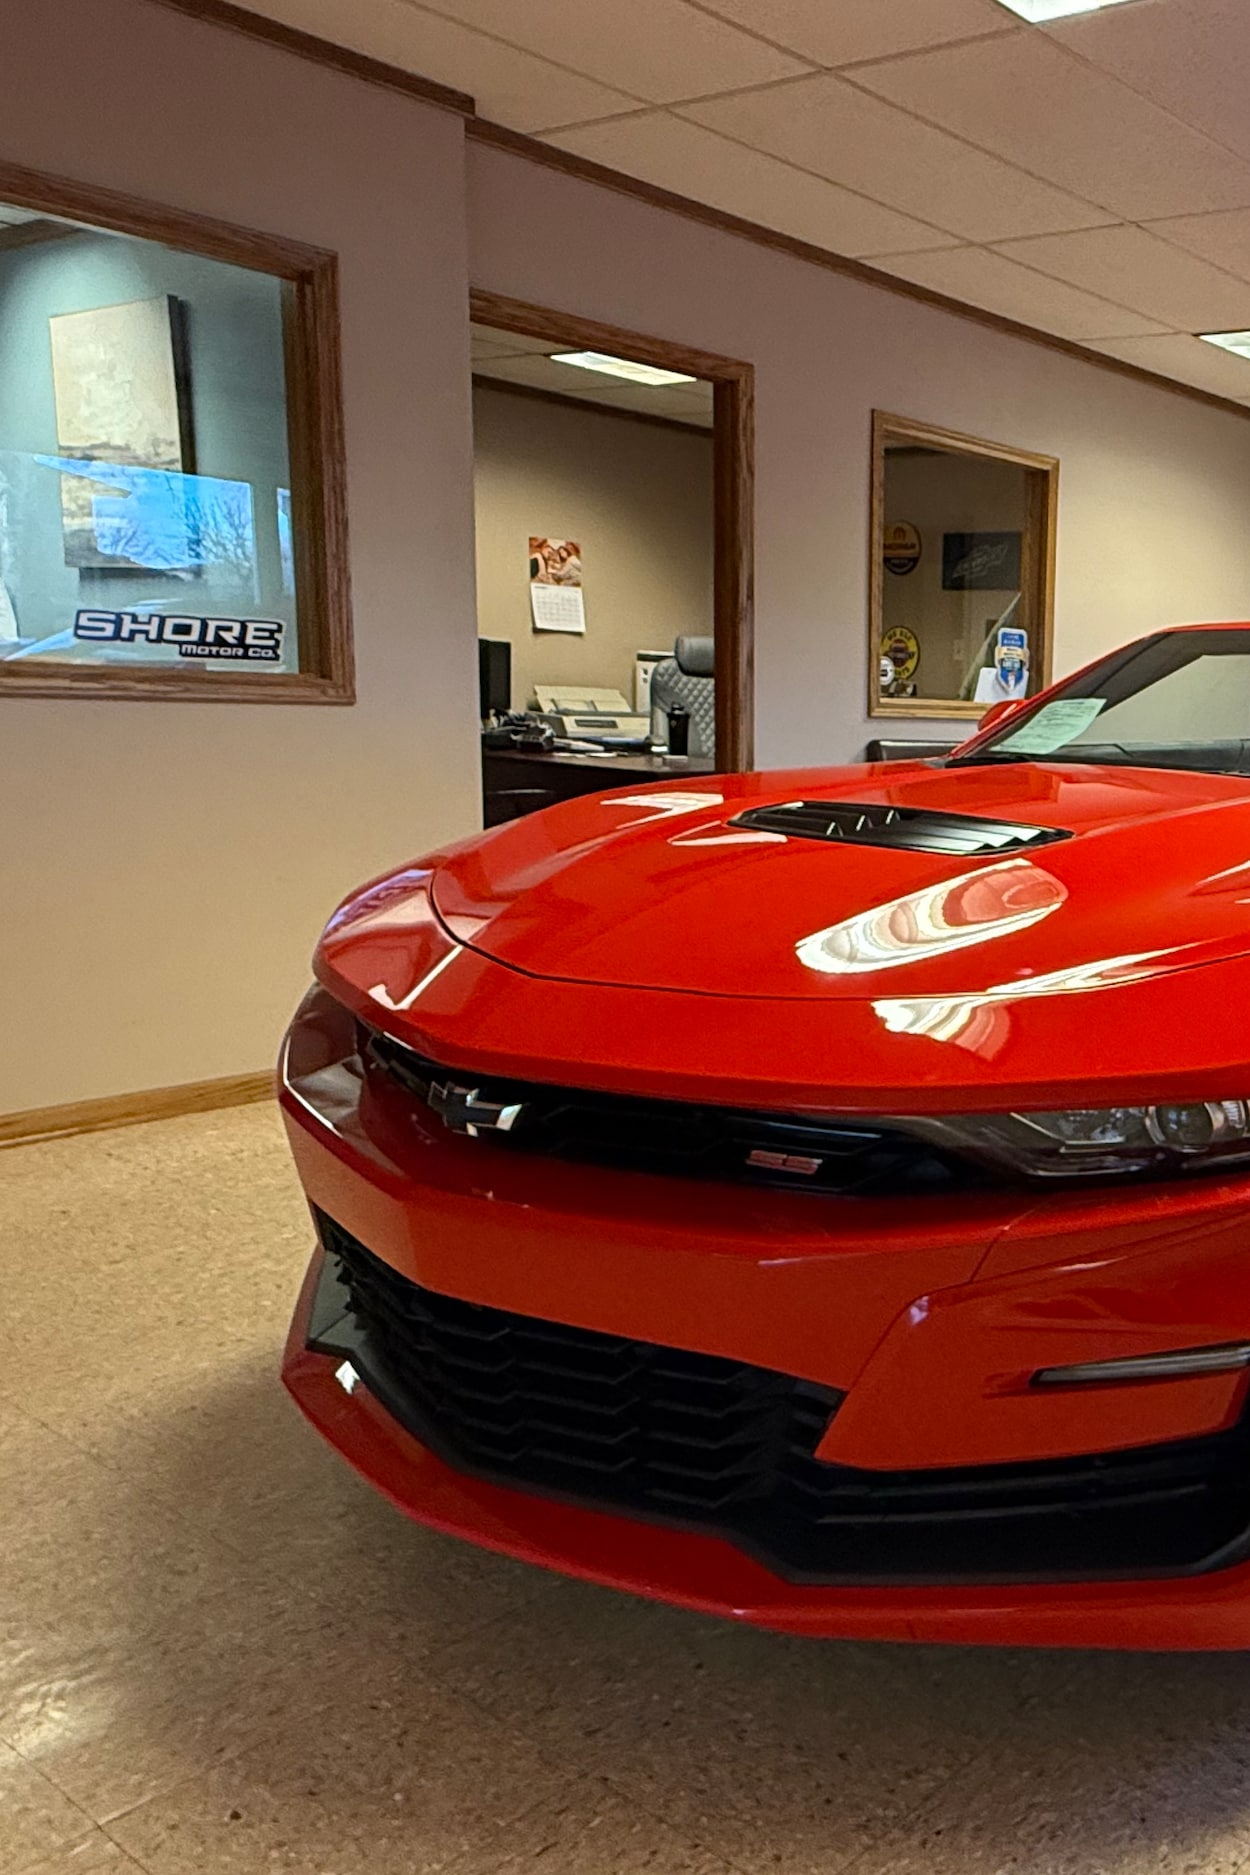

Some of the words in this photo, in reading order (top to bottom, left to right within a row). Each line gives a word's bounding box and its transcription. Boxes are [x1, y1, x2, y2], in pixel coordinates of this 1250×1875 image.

[76, 611, 279, 646] SHORE
[181, 643, 244, 657] MOTOR
[247, 647, 276, 658] CO.
[745, 1149, 823, 1175] SS
